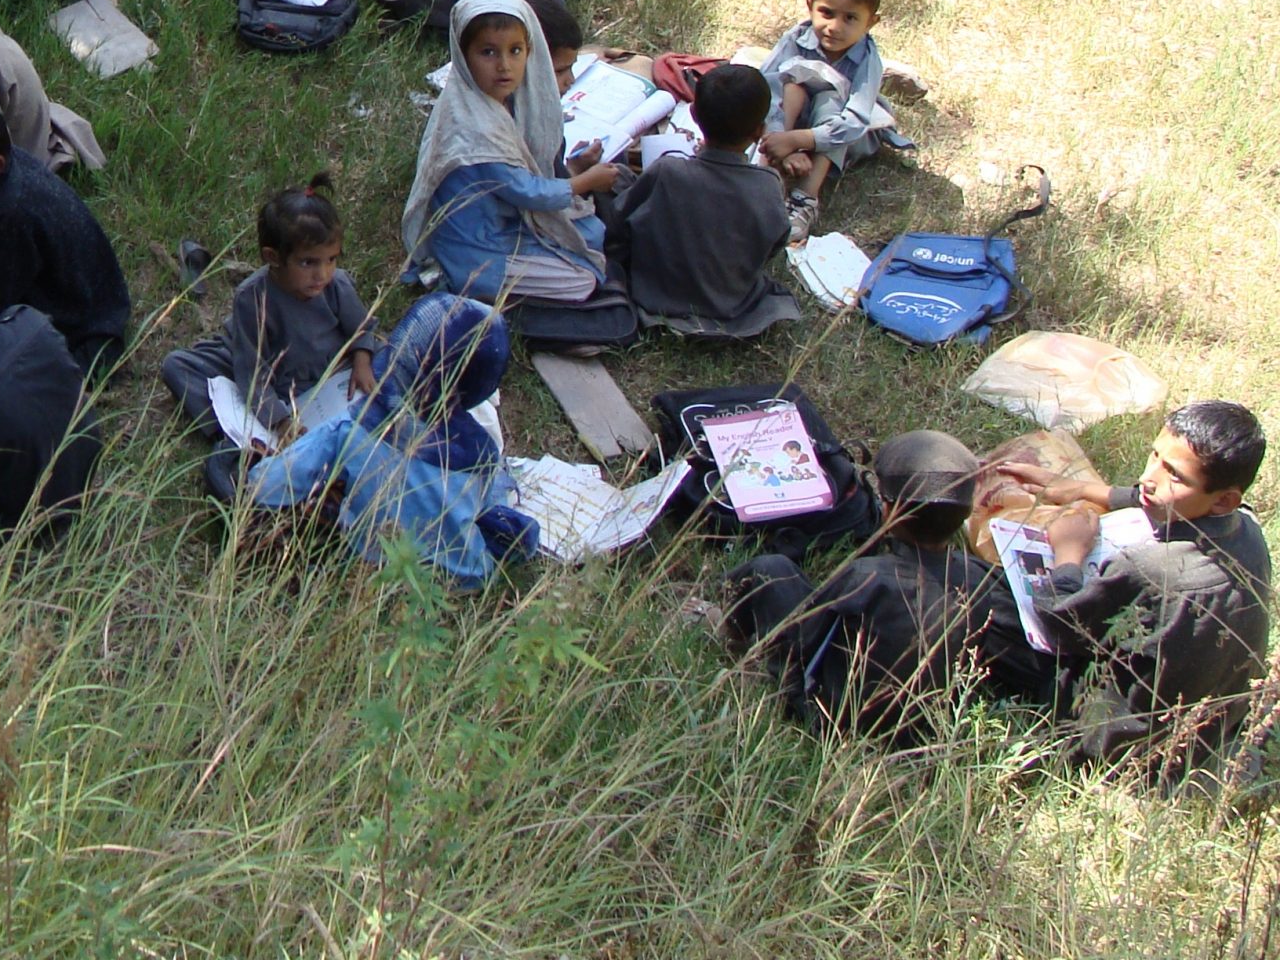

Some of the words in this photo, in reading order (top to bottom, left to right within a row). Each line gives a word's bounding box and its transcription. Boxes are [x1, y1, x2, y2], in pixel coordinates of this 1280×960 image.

[933, 253, 975, 267] unicef
[717, 434, 730, 442] My
[762, 425, 793, 436] Reader
